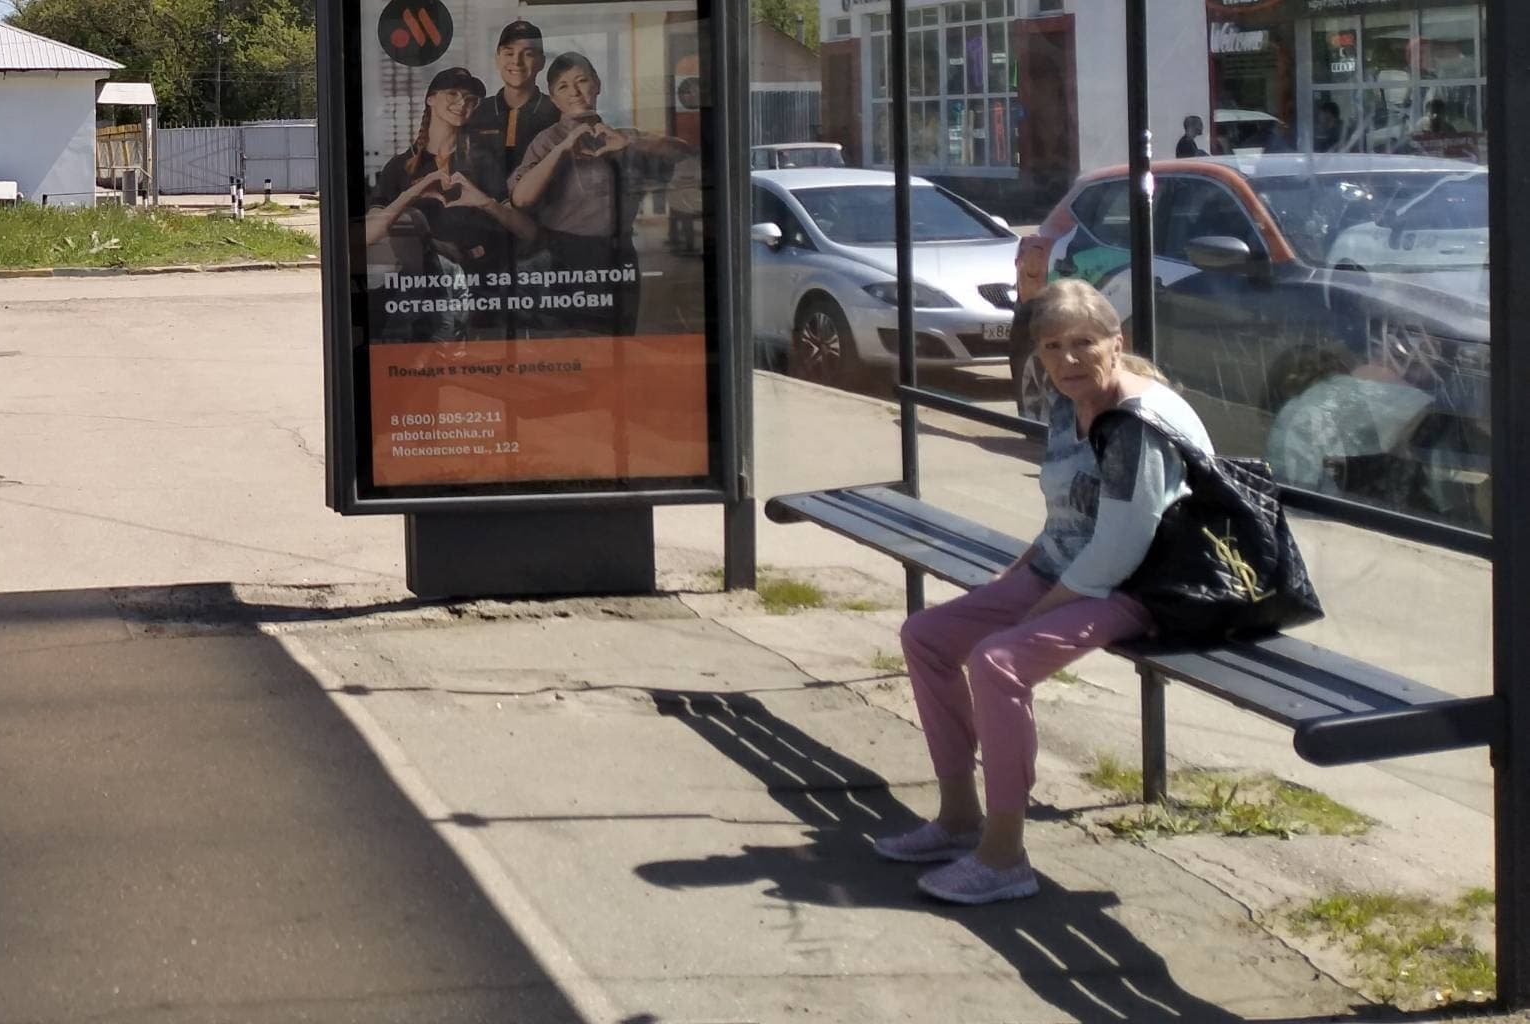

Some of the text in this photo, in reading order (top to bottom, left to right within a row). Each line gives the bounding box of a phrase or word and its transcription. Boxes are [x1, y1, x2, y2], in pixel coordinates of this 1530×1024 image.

[384, 271, 479, 291] Приходи
[486, 273, 512, 287] за
[517, 264, 636, 289] зарплатой
[385, 291, 614, 314] оставайся по любви
[388, 363, 445, 378] Попади
[461, 364, 503, 377] точку
[519, 359, 582, 378] работой
[390, 414, 400, 426] 8
[401, 413, 436, 428] (800)
[391, 427, 495, 442] rabotaitochka.ru
[392, 444, 471, 458] Московское
[495, 441, 520, 454] 122
